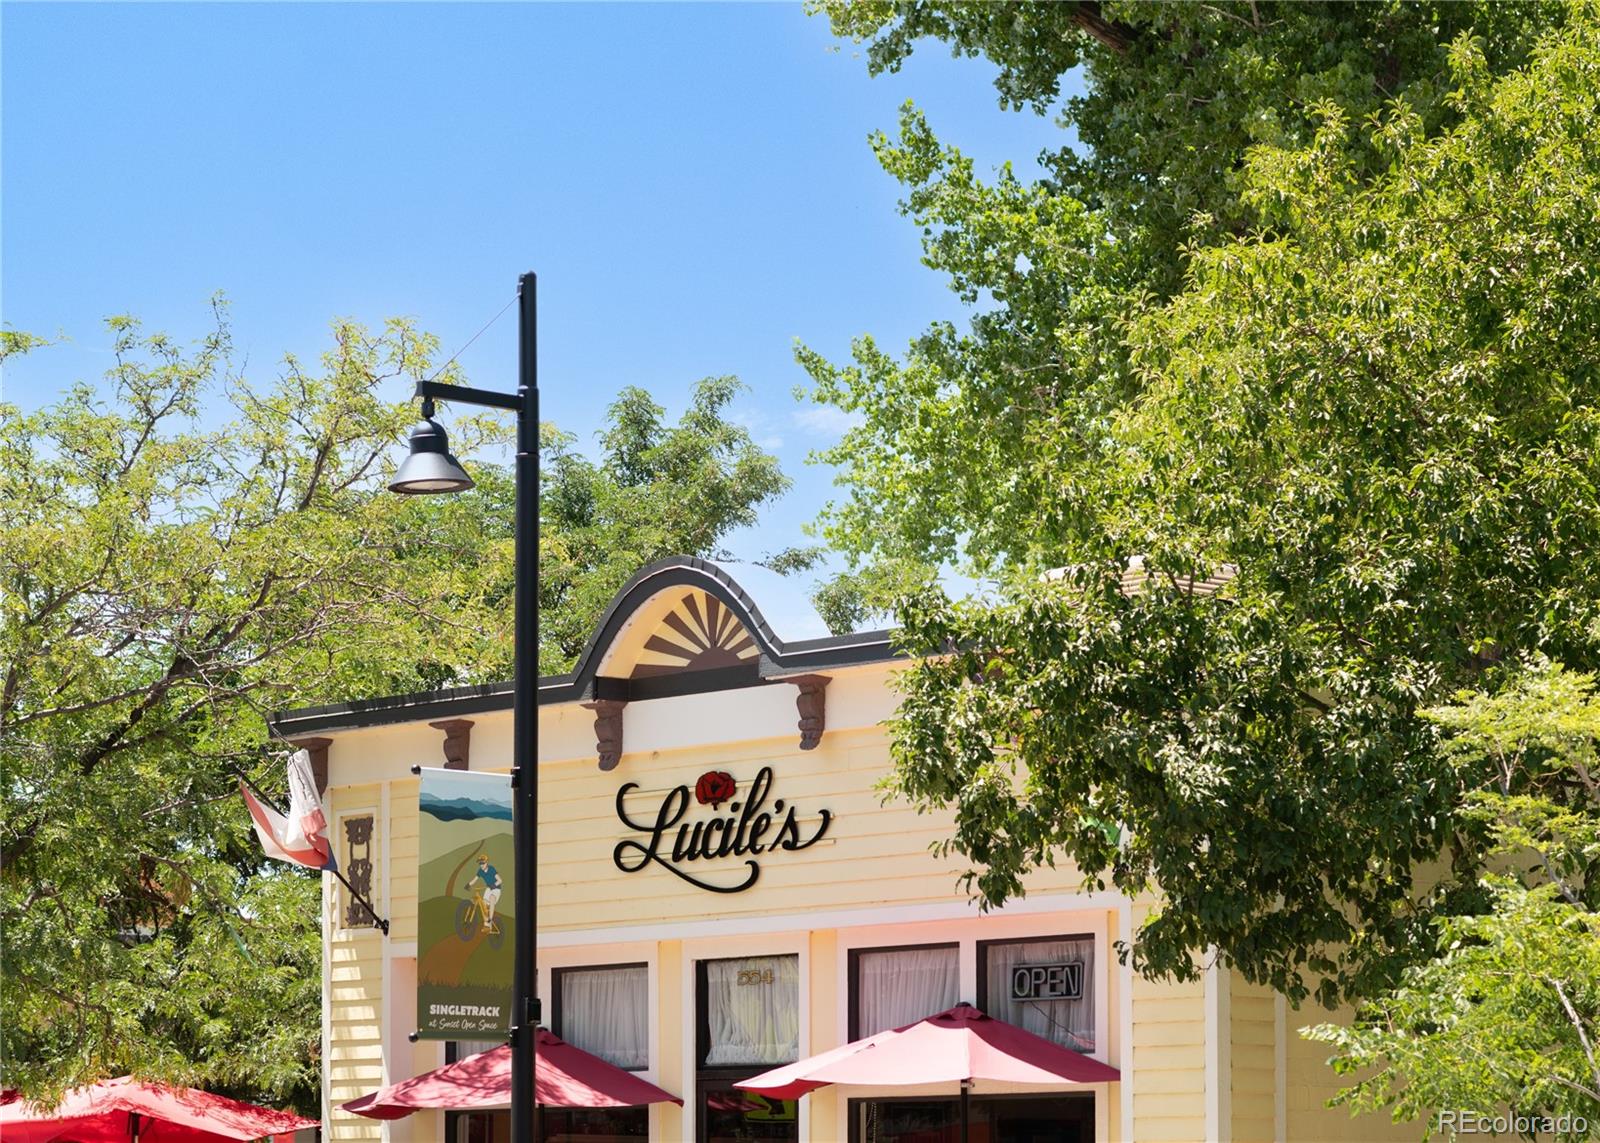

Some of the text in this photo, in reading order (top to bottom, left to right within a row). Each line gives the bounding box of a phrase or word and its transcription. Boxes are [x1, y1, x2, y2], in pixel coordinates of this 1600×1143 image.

[613, 766, 831, 893] Lucile's
[737, 969, 775, 986] 554
[1014, 967, 1079, 997] OPEN
[429, 1004, 500, 1017] SINGLETRACK
[428, 1018, 498, 1031] at Sunset Open Space
